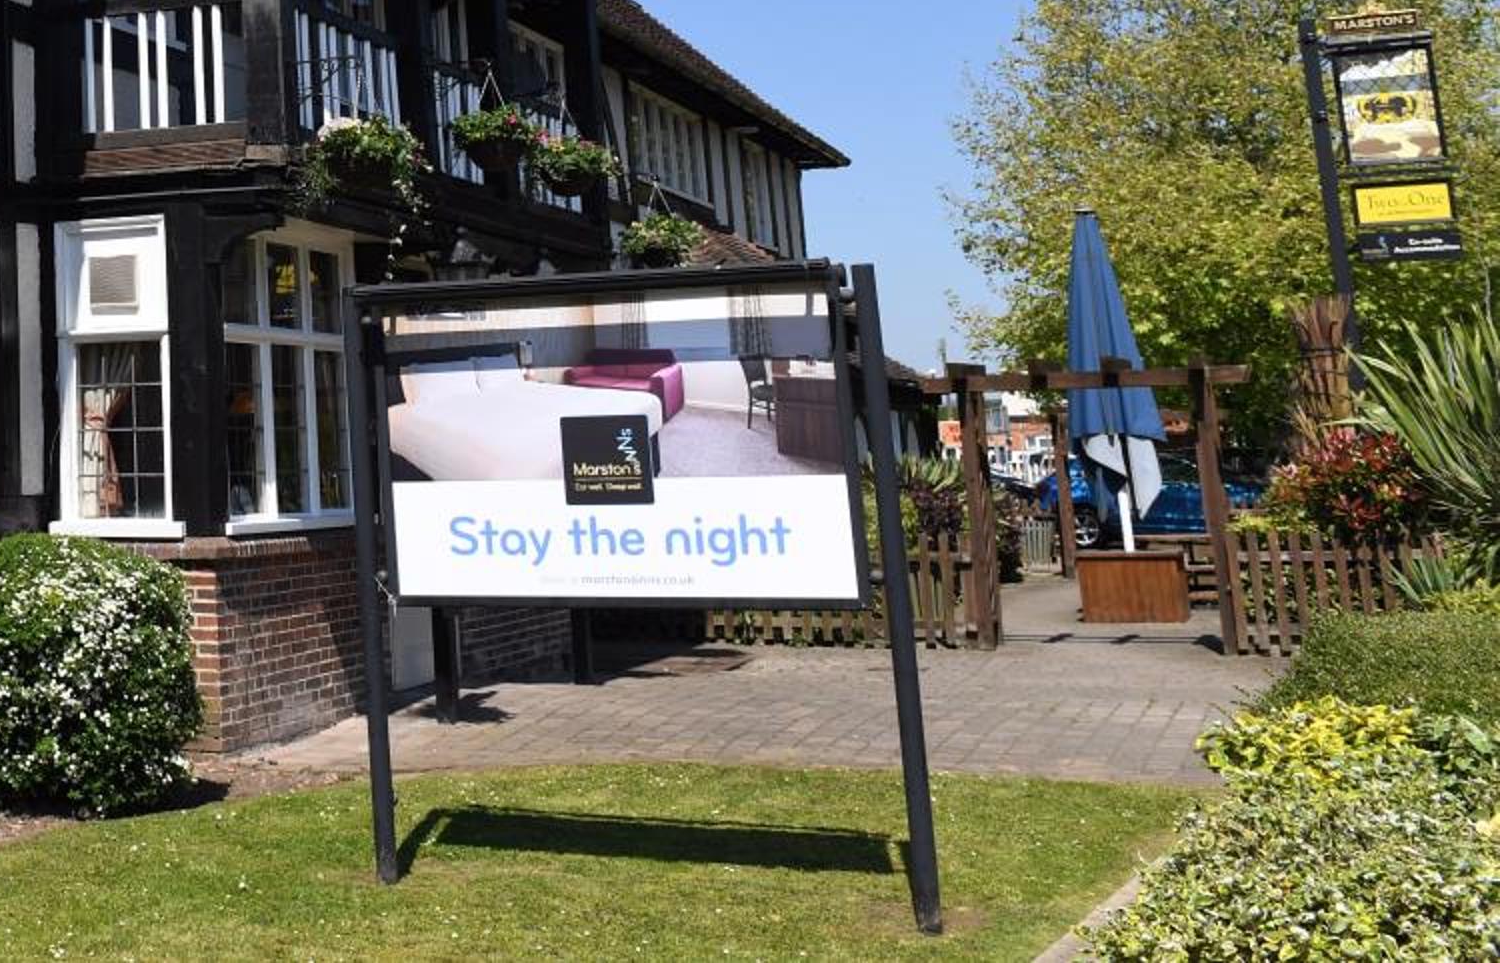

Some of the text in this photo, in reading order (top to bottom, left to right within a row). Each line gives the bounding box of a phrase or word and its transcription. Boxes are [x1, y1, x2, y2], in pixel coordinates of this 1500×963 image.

[449, 512, 792, 567] Stay the night
